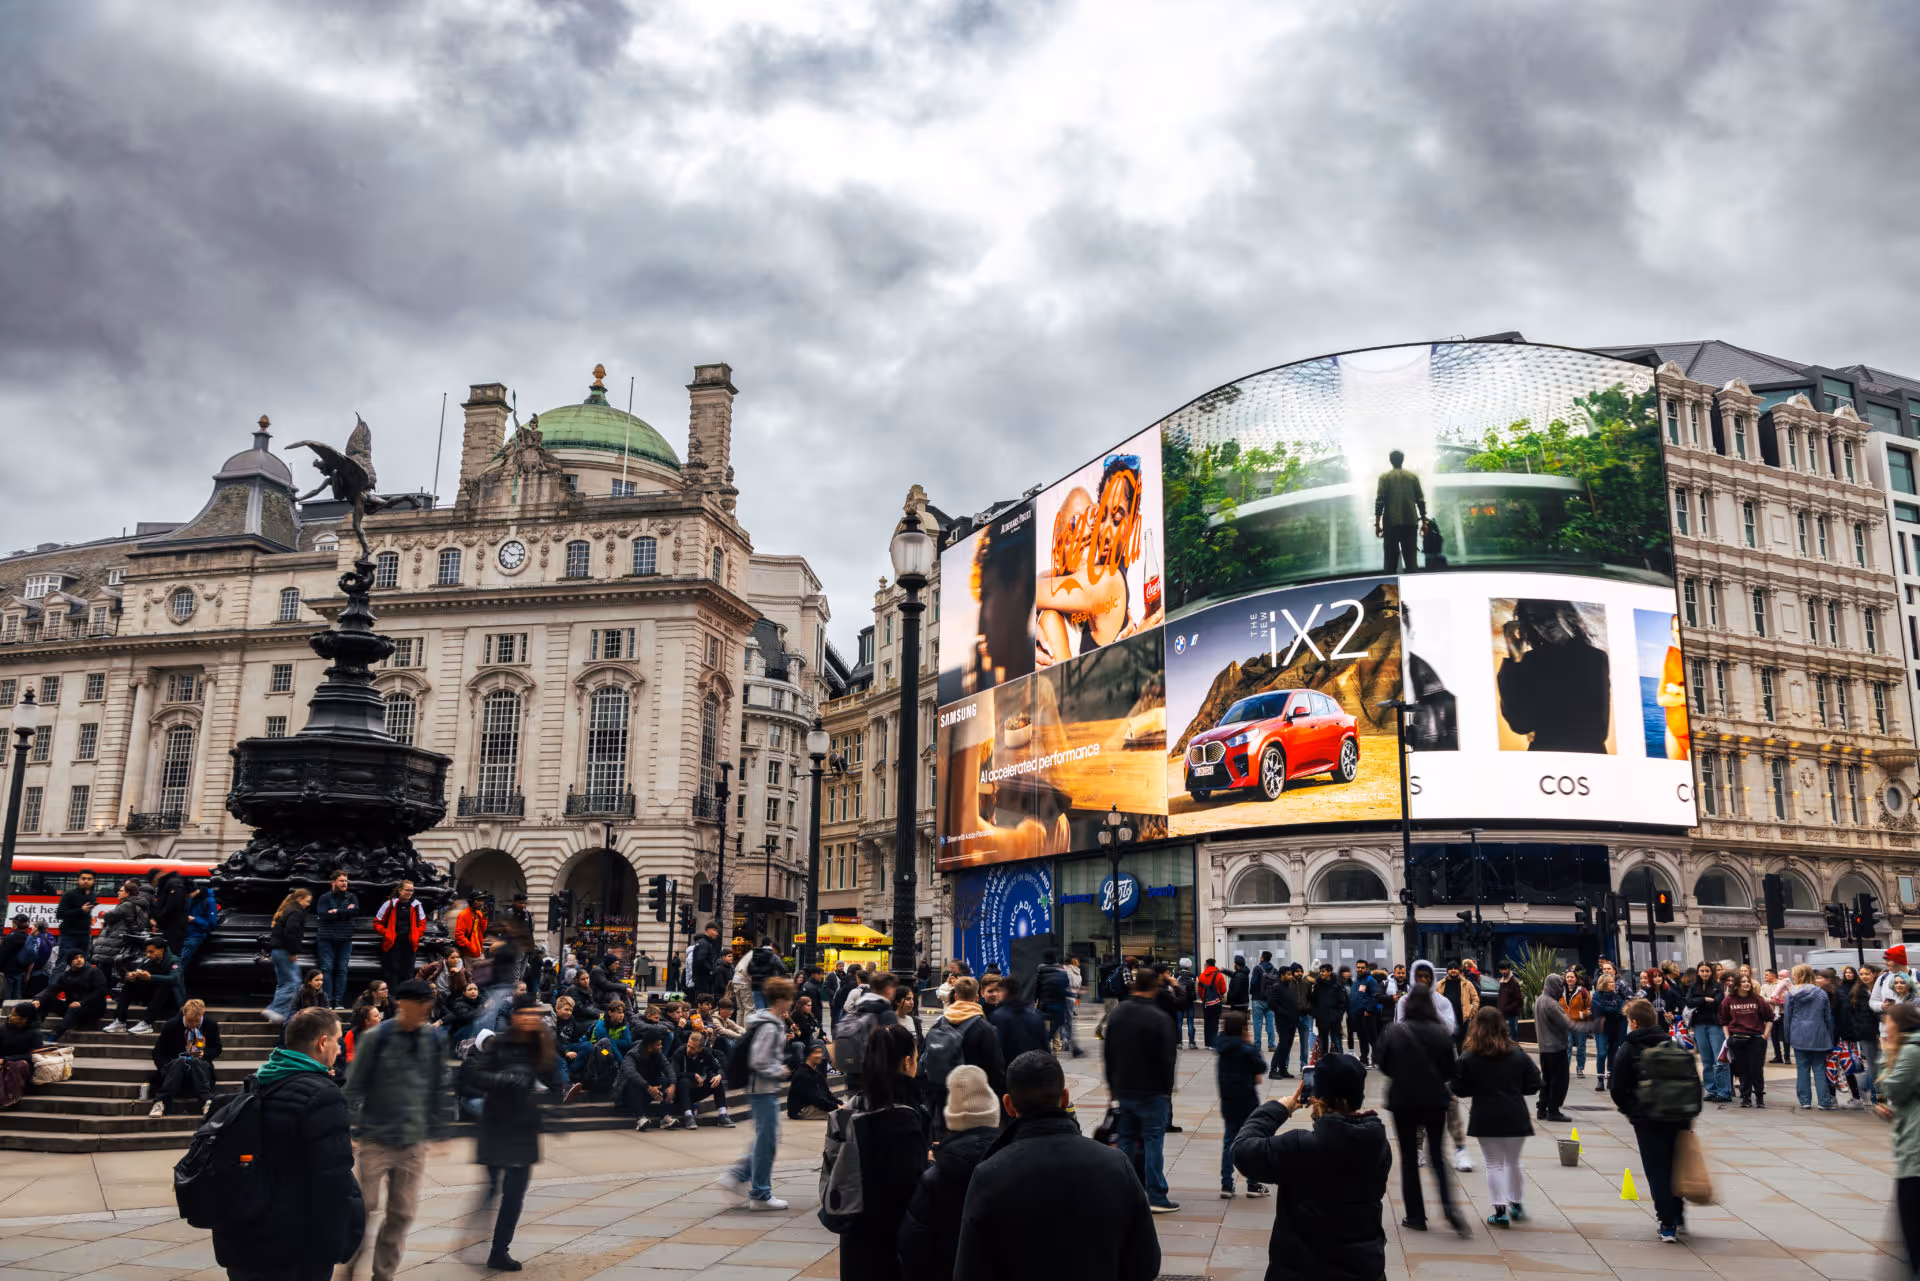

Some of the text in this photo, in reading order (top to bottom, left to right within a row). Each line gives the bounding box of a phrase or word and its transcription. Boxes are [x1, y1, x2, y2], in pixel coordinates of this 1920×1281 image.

[1250, 613, 1258, 638] THE
[1260, 611, 1268, 638] NEW
[1269, 599, 1369, 668] iX2
[940, 703, 977, 728] SAMSUNG
[988, 758, 1037, 783] accelerated
[1038, 743, 1100, 774] performance
[1539, 775, 1590, 796] COS
[991, 896, 1000, 923] WITH
[997, 876, 1007, 894] YOU
[1147, 884, 1177, 898] beauty
[15, 904, 37, 914] Gut
[1009, 900, 1037, 936] PICCADILLY
[980, 920, 988, 966] BEATING
